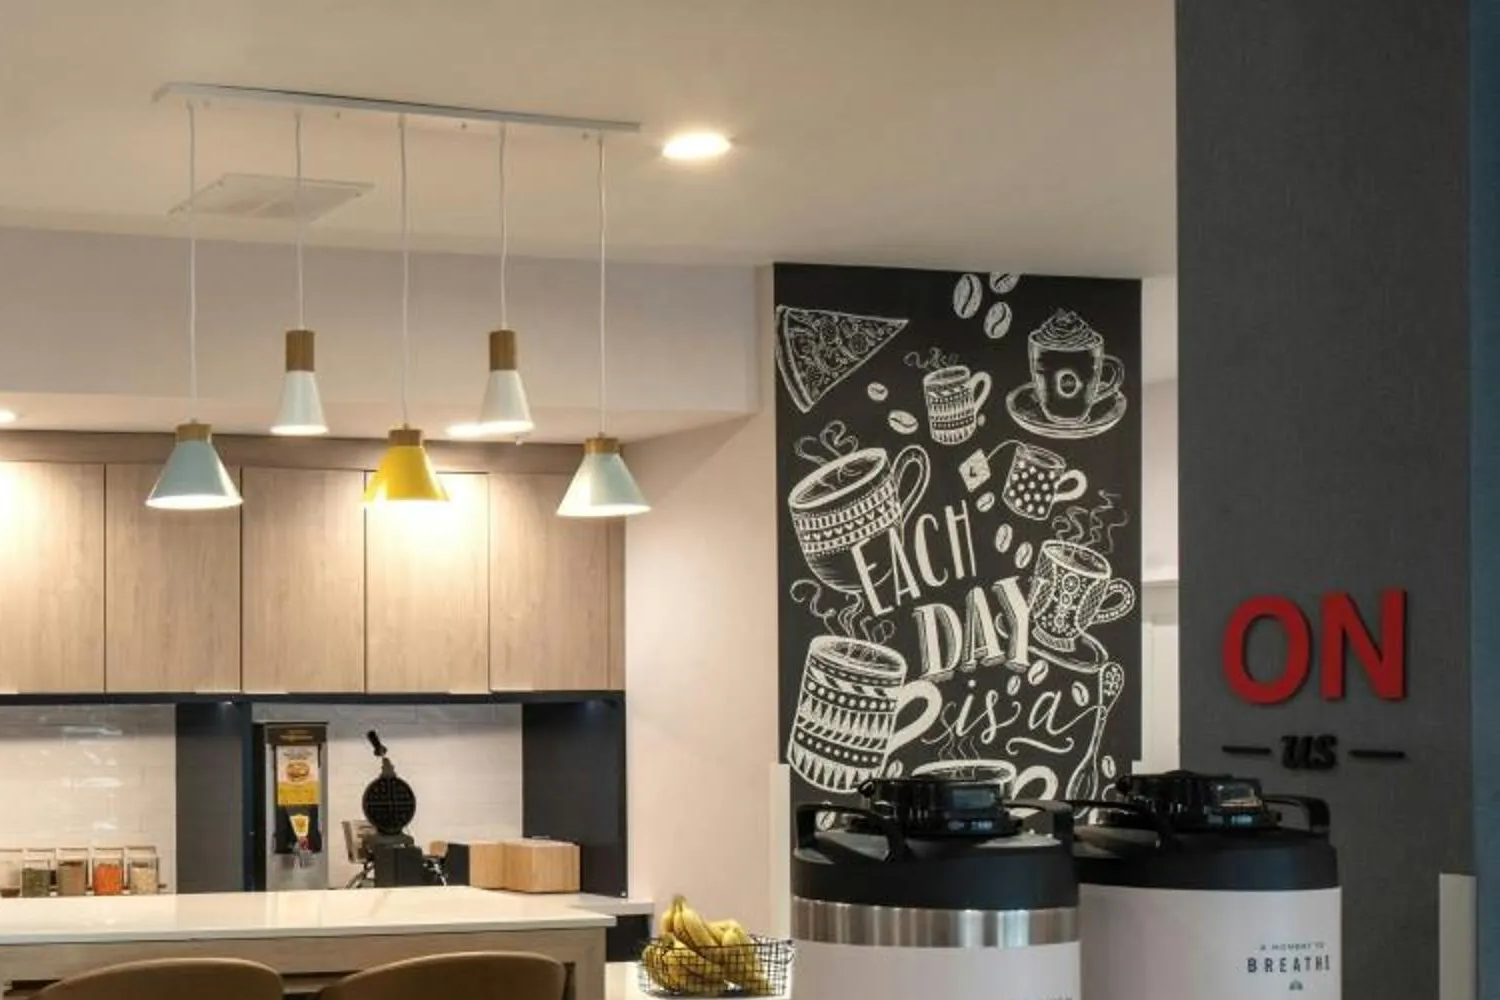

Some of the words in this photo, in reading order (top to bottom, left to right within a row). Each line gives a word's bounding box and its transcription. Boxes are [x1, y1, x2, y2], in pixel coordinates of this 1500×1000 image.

[850, 499, 978, 616] EACH
[912, 576, 1046, 683] DAY
[1221, 586, 1407, 705] ON
